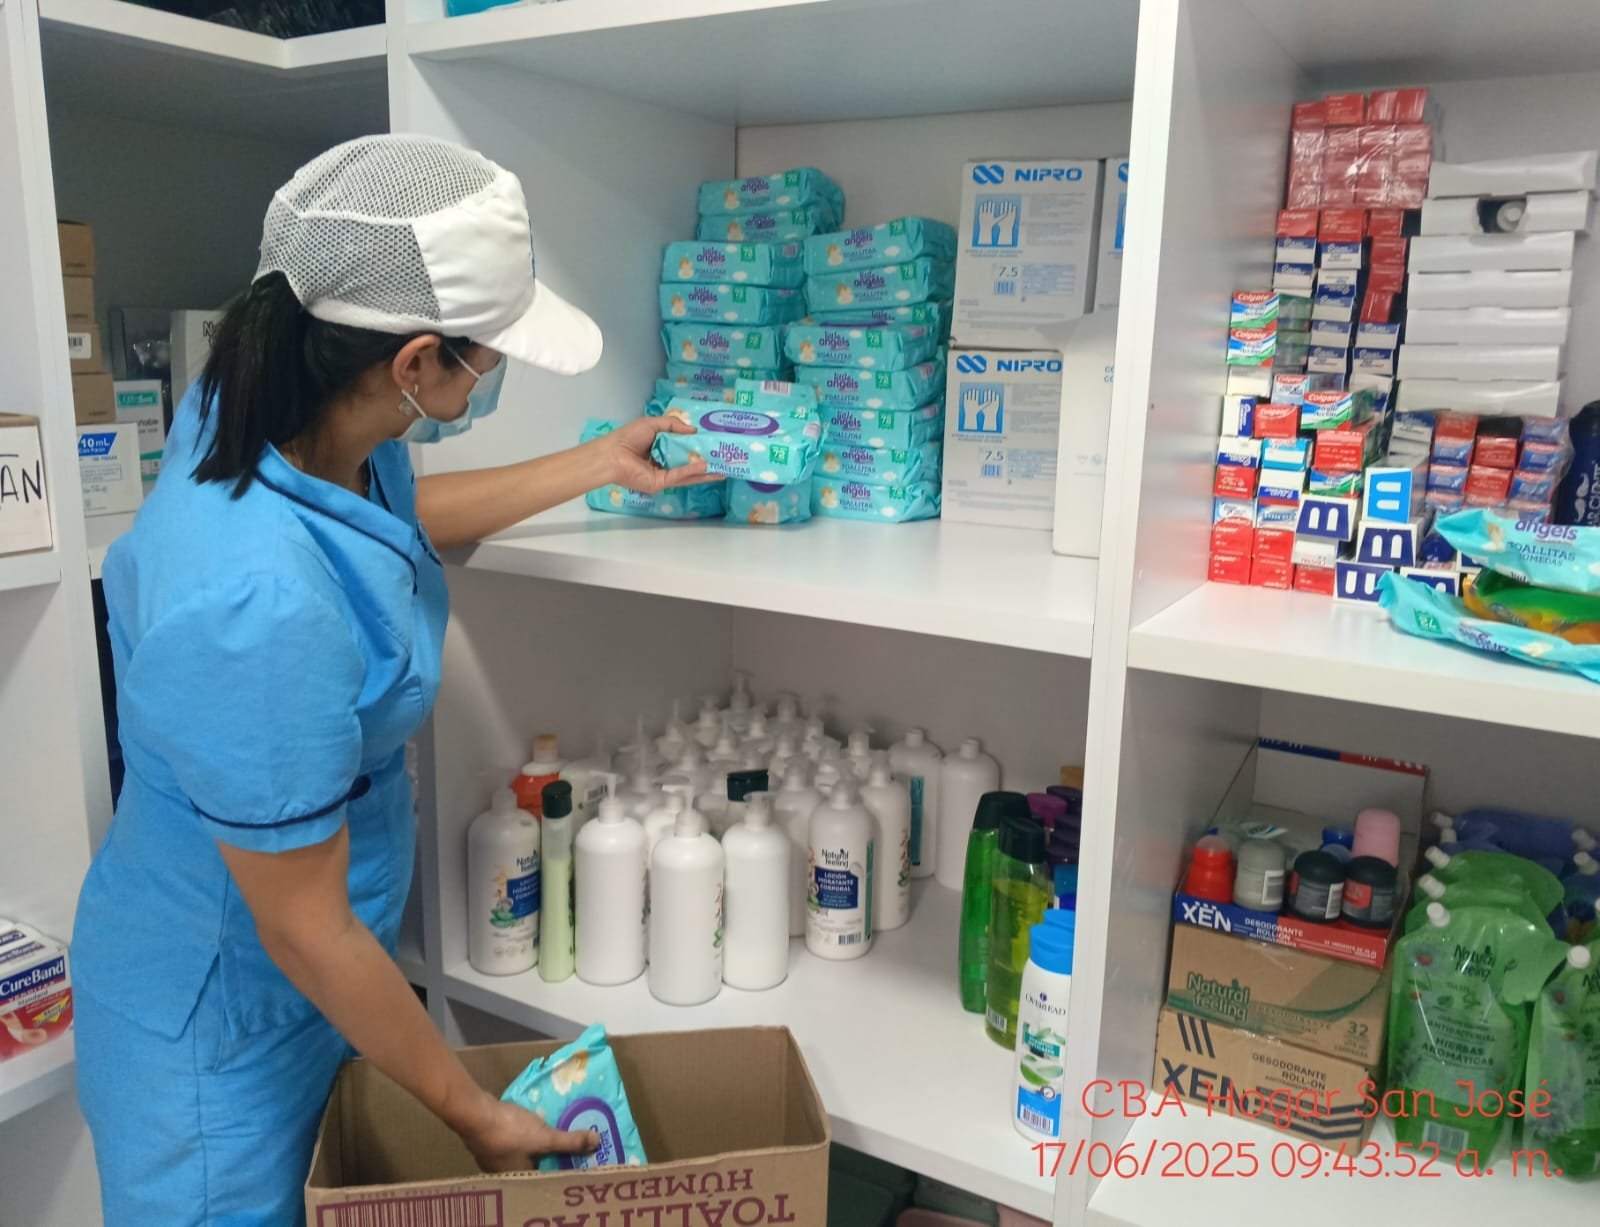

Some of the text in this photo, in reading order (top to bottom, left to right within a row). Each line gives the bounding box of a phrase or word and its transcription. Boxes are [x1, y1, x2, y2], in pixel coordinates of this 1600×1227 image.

[1015, 167, 1083, 182] NIPRO
[697, 252, 725, 265] angels
[999, 265, 1018, 277] 7.5
[689, 292, 718, 305] angels
[819, 336, 850, 350] angels
[996, 359, 1062, 372] NIPRO
[827, 377, 859, 391] angels
[1308, 393, 1342, 403] Colgate
[831, 417, 861, 431] angels
[81, 437, 110, 448] 10 mL
[719, 441, 740, 452] little
[710, 448, 749, 463] angels
[842, 451, 874, 465] angels
[984, 450, 1004, 462] 7.5
[841, 483, 871, 498] angels
[1514, 520, 1578, 541] angels
[1507, 541, 1576, 562] TOALLITAS
[1244, 917, 1304, 937] DESODORANTE
[1256, 927, 1292, 942] ROLL-ON
[0, 959, 64, 997] CureBand
[1187, 971, 1250, 1005] Natural
[1194, 992, 1249, 1023] feeling
[1346, 1020, 1369, 1036] 32
[1252, 1052, 1327, 1081] DESODORANTE
[1162, 1057, 1249, 1113] XEN
[1282, 1071, 1326, 1091] ROLL-ON
[563, 1168, 754, 1207] HÚMEDAS
